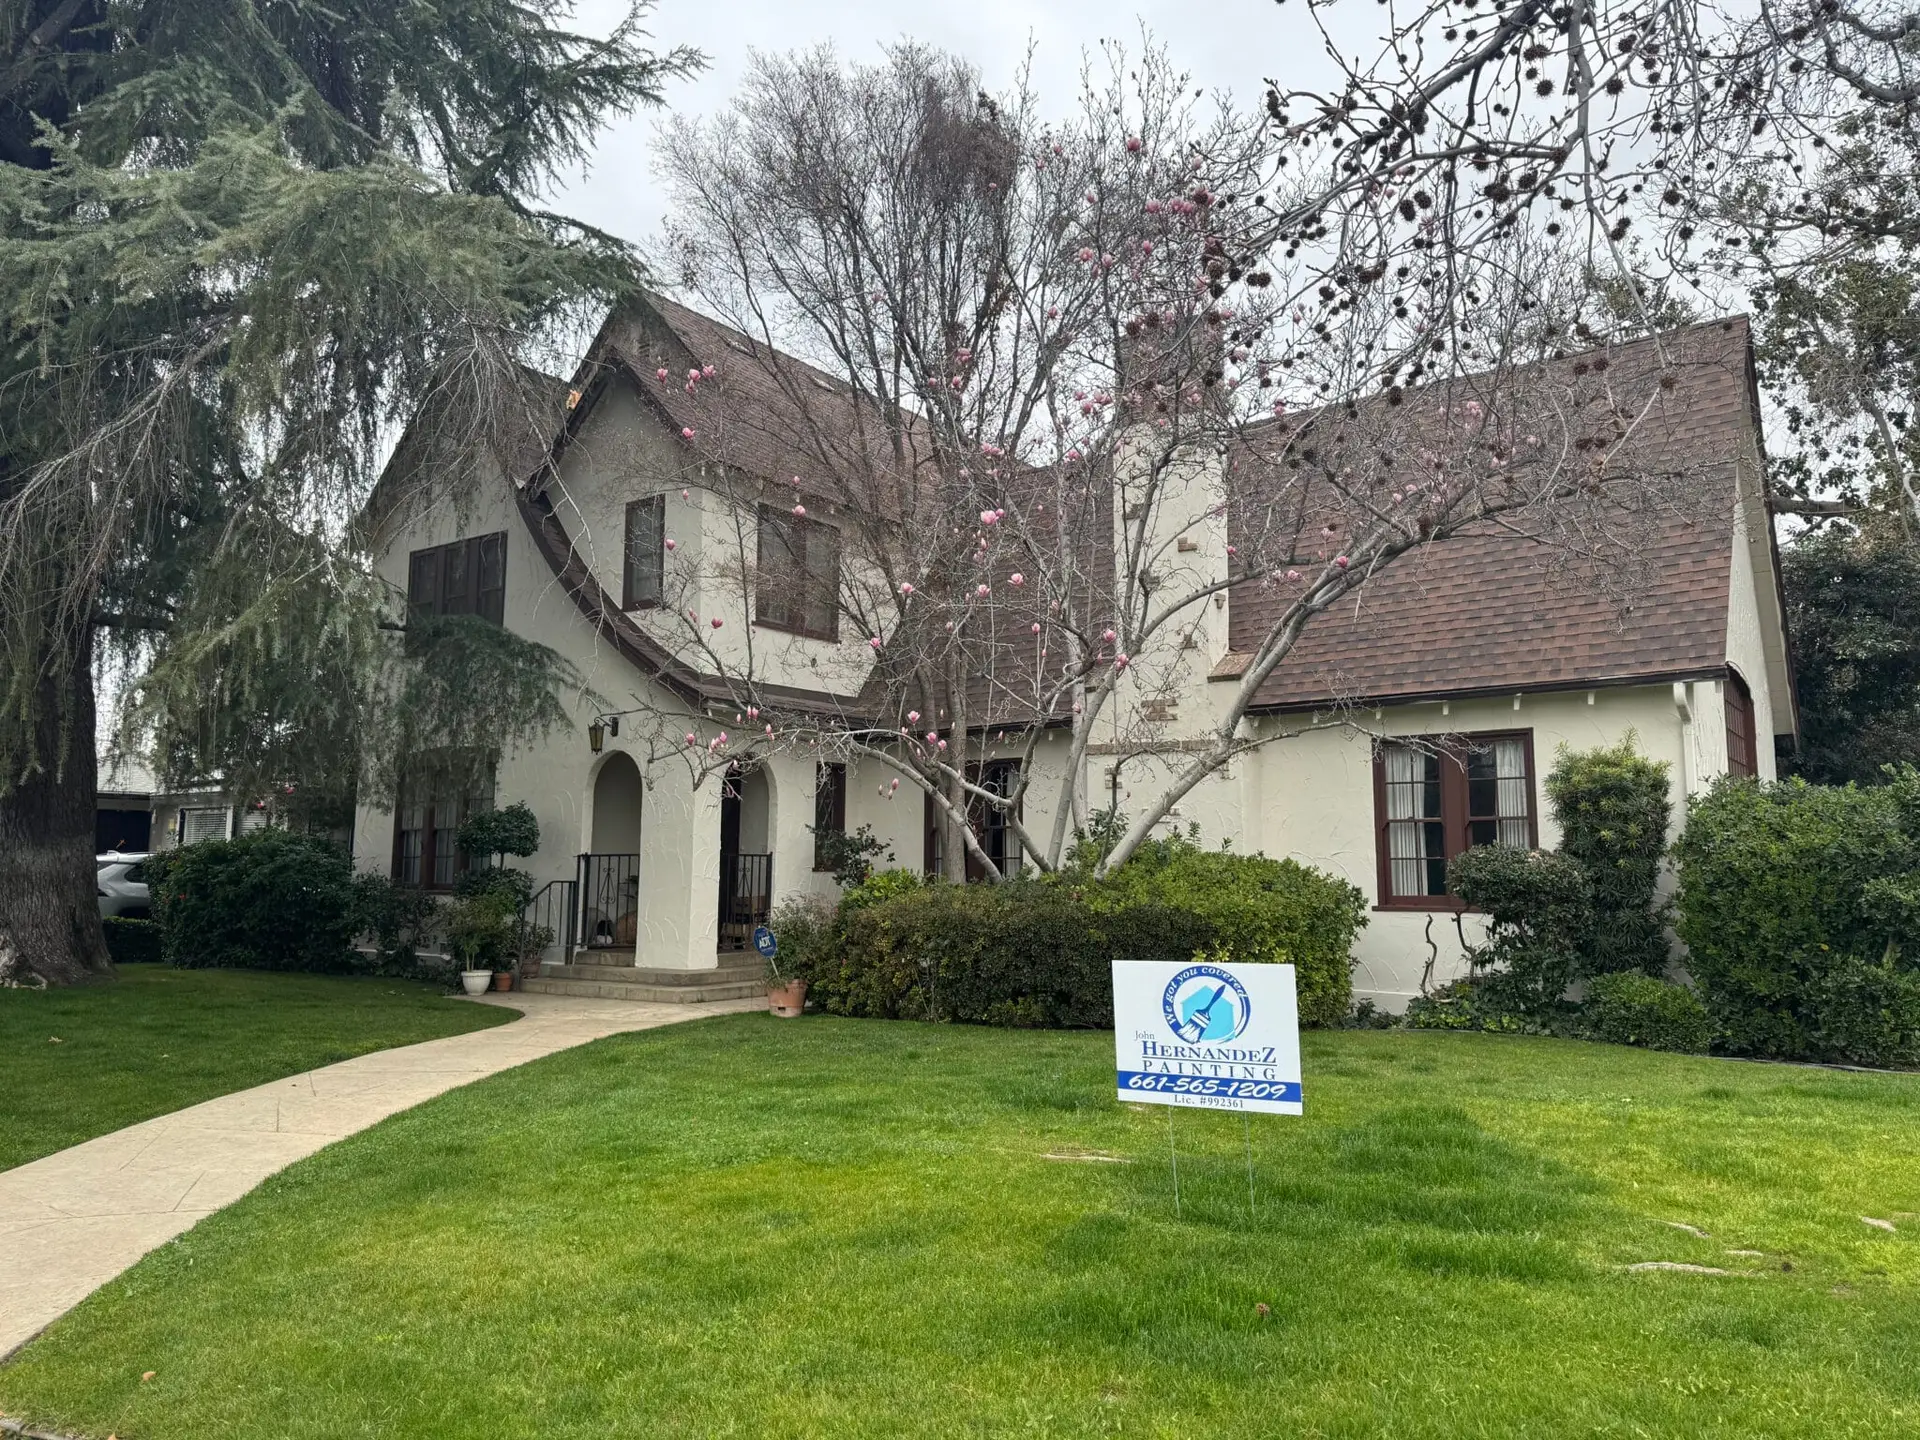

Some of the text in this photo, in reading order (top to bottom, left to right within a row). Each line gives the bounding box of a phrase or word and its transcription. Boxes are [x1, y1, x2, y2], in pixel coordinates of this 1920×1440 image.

[758, 935, 771, 948] ADT
[1164, 966, 1248, 1025] We got you covered
[1134, 1030, 1155, 1041] John
[1141, 1040, 1277, 1063] HERNANDEZ
[1142, 1060, 1277, 1080] PAINTING
[1128, 1074, 1287, 1099] 661-565-1209
[1174, 1094, 1244, 1108] Lic. #992361
